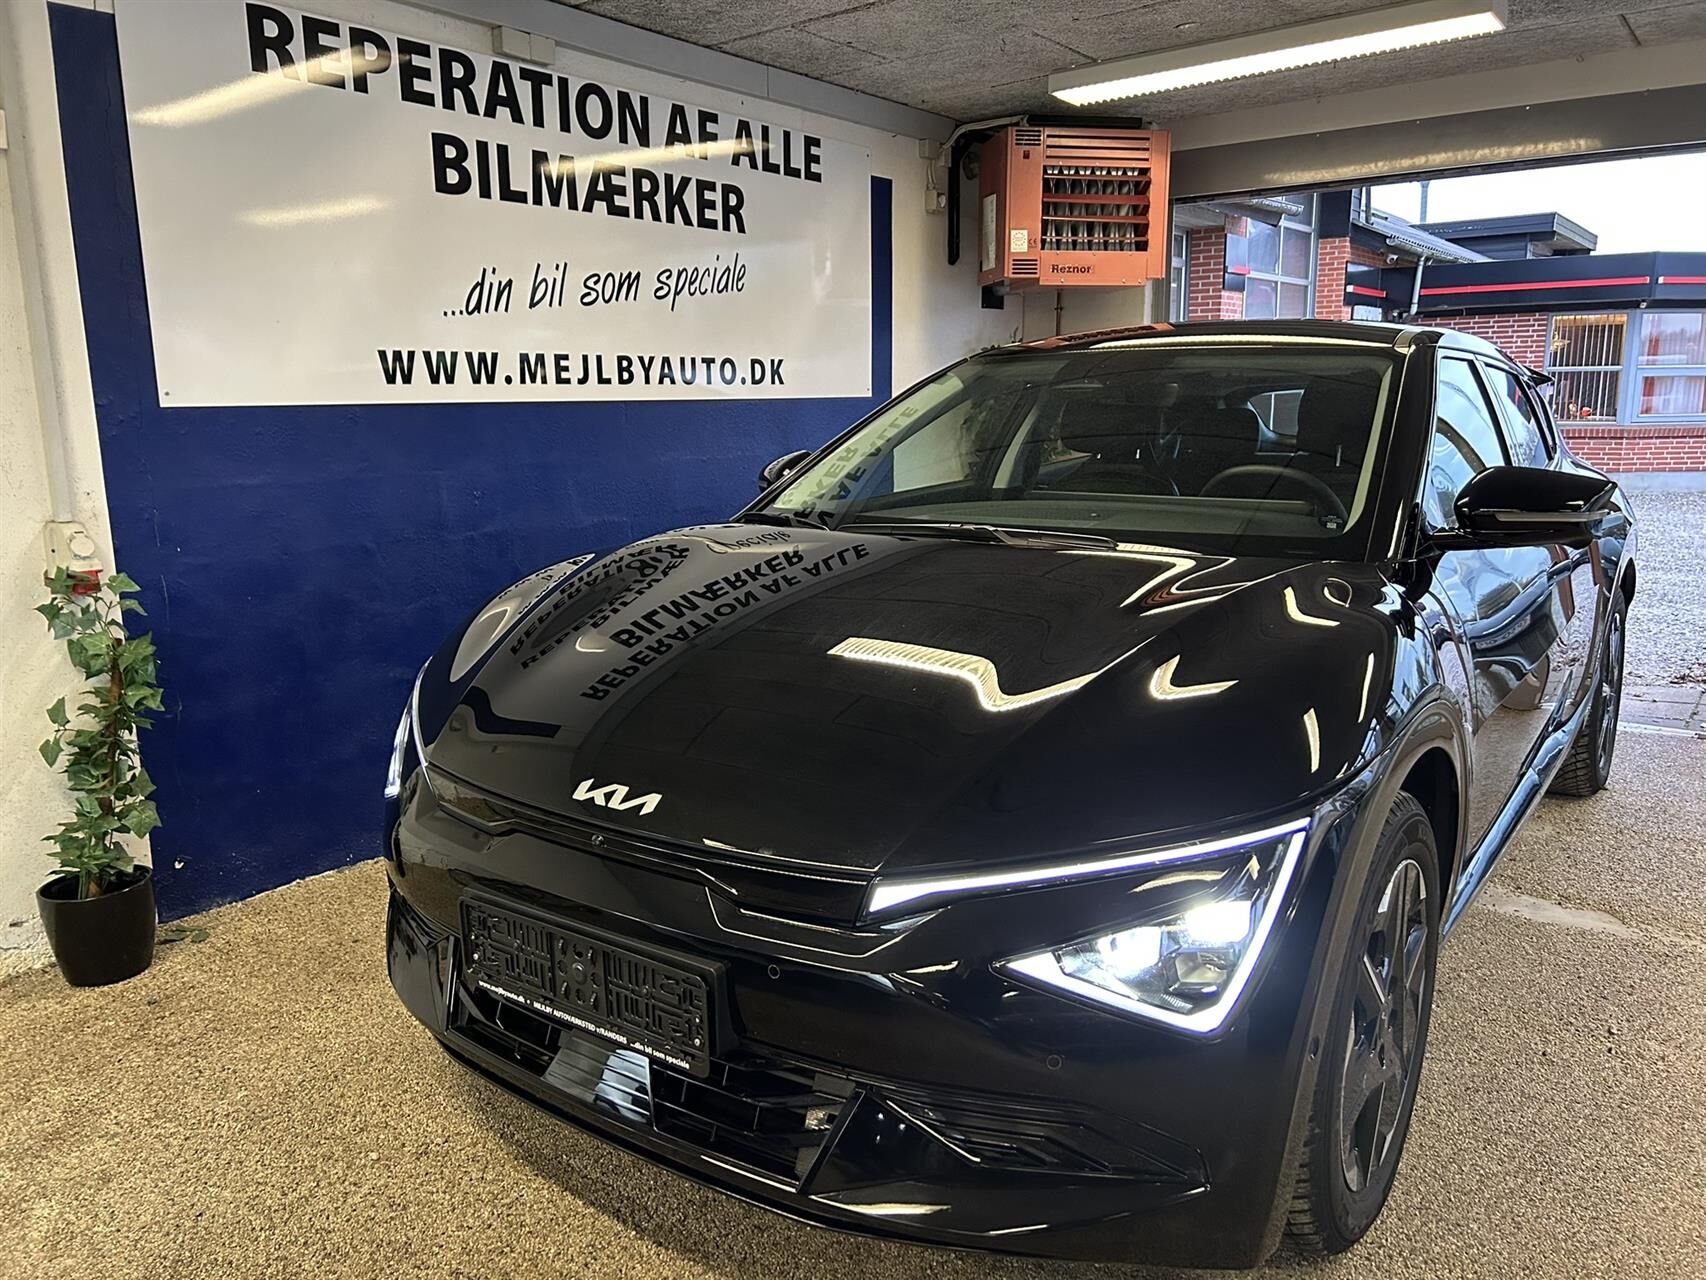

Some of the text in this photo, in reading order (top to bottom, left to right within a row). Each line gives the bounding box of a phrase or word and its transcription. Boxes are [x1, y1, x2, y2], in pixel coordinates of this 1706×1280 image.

[246, 2, 822, 183] REPERATION AF ALLE
[431, 132, 747, 234] BILMÆRKER
[528, 261, 568, 309] bil
[580, 270, 641, 307] som
[653, 251, 747, 312] speciale
[1050, 263, 1093, 275] Reznor
[377, 349, 786, 386] WWW.MEJLBYAUTO.DK
[572, 778, 663, 816] KIA
